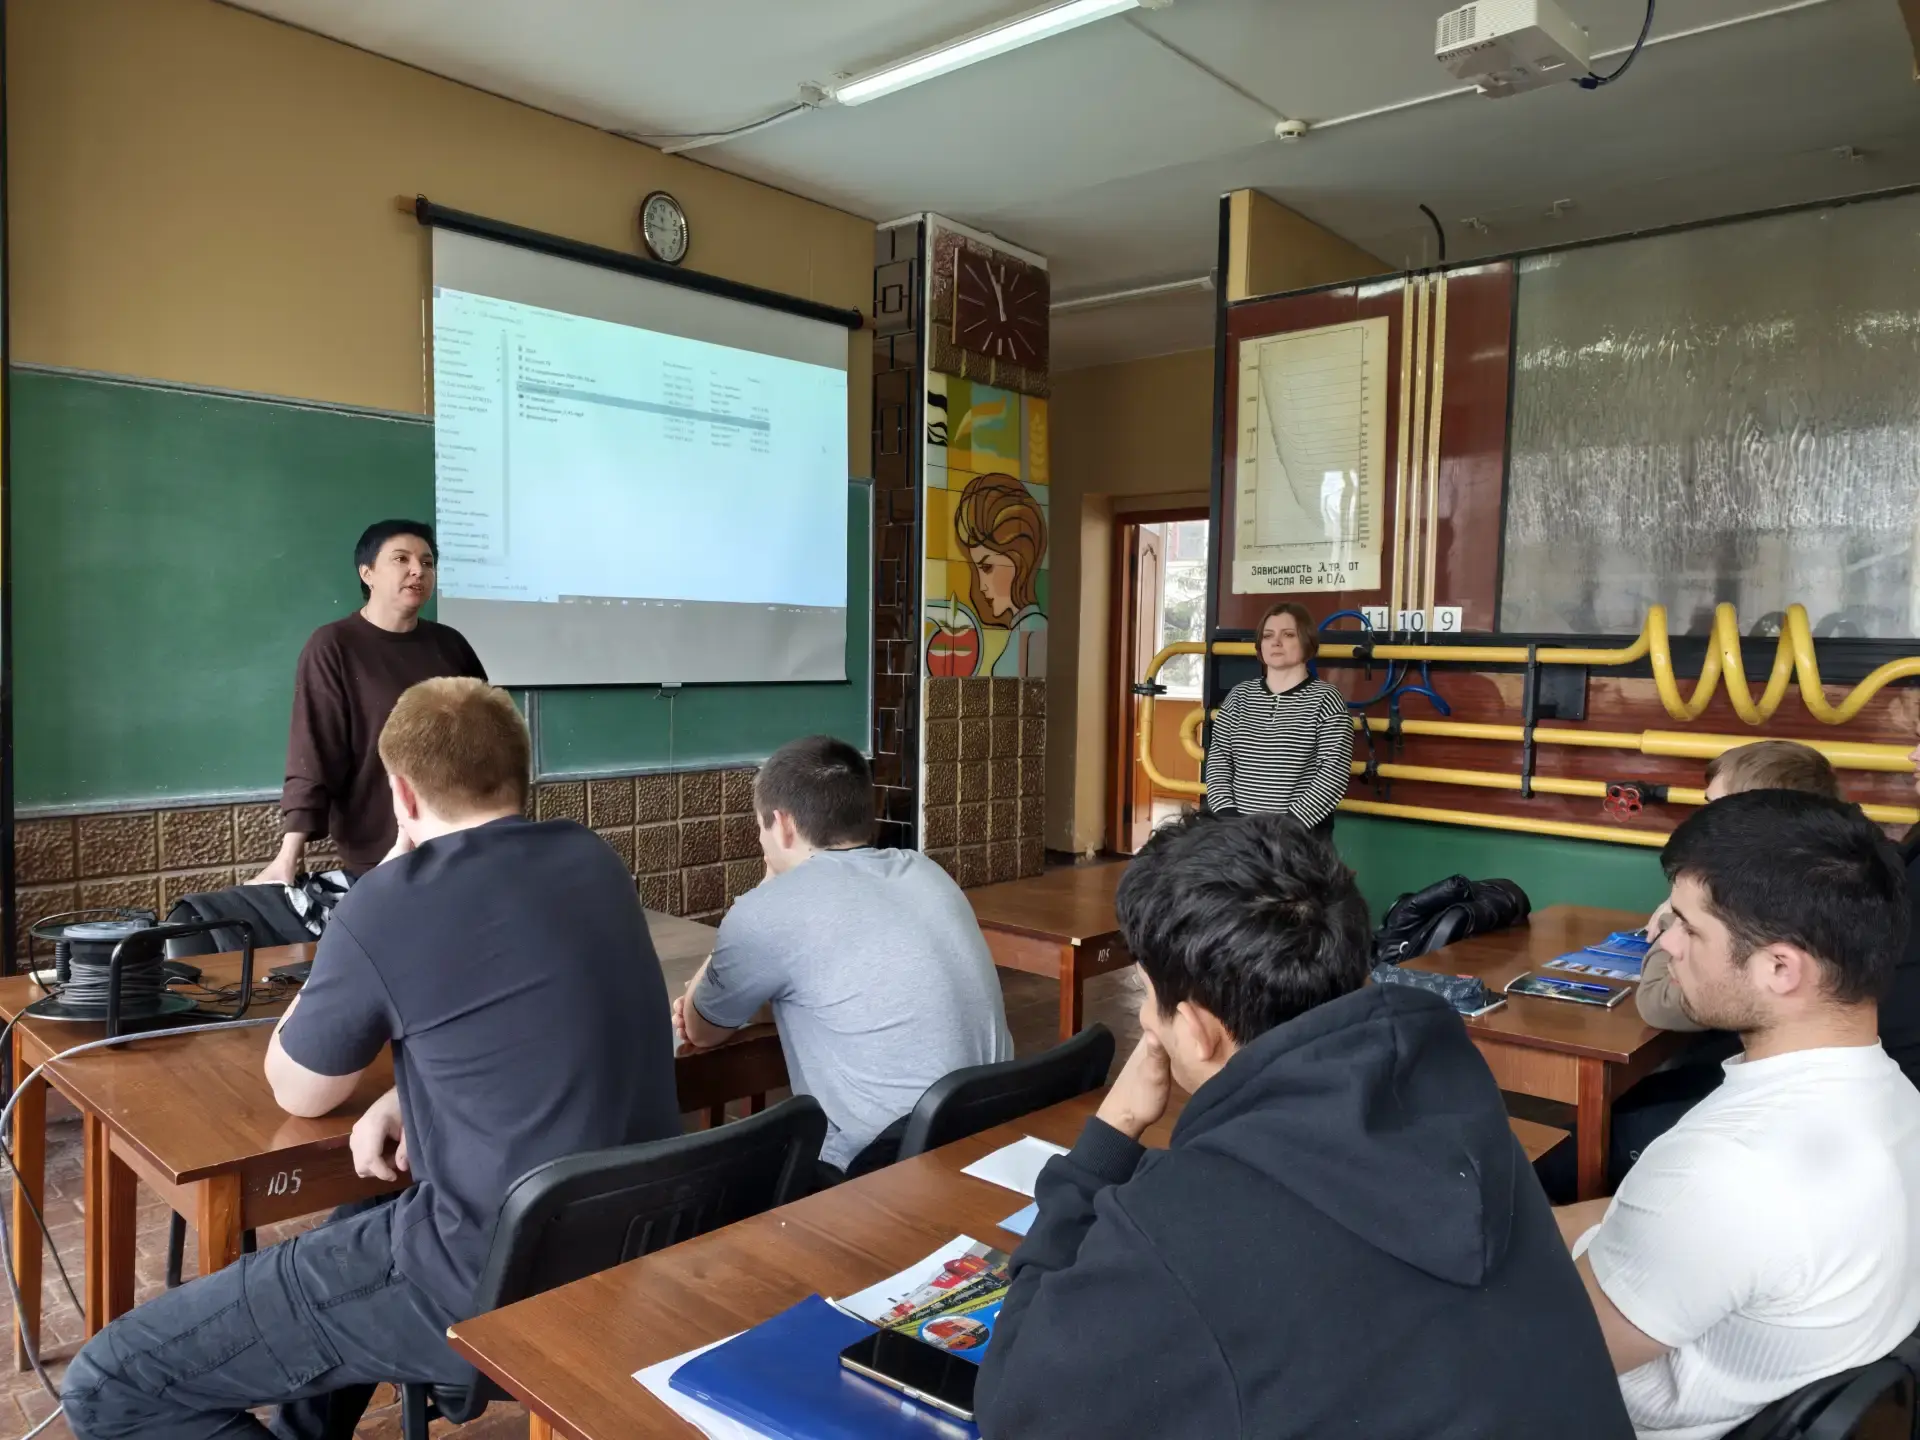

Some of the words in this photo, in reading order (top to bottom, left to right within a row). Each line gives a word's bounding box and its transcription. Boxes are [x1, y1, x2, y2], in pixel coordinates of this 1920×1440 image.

[1399, 611, 1424, 633] 10
[1441, 611, 1454, 631] 9
[267, 1168, 303, 1197] 105
